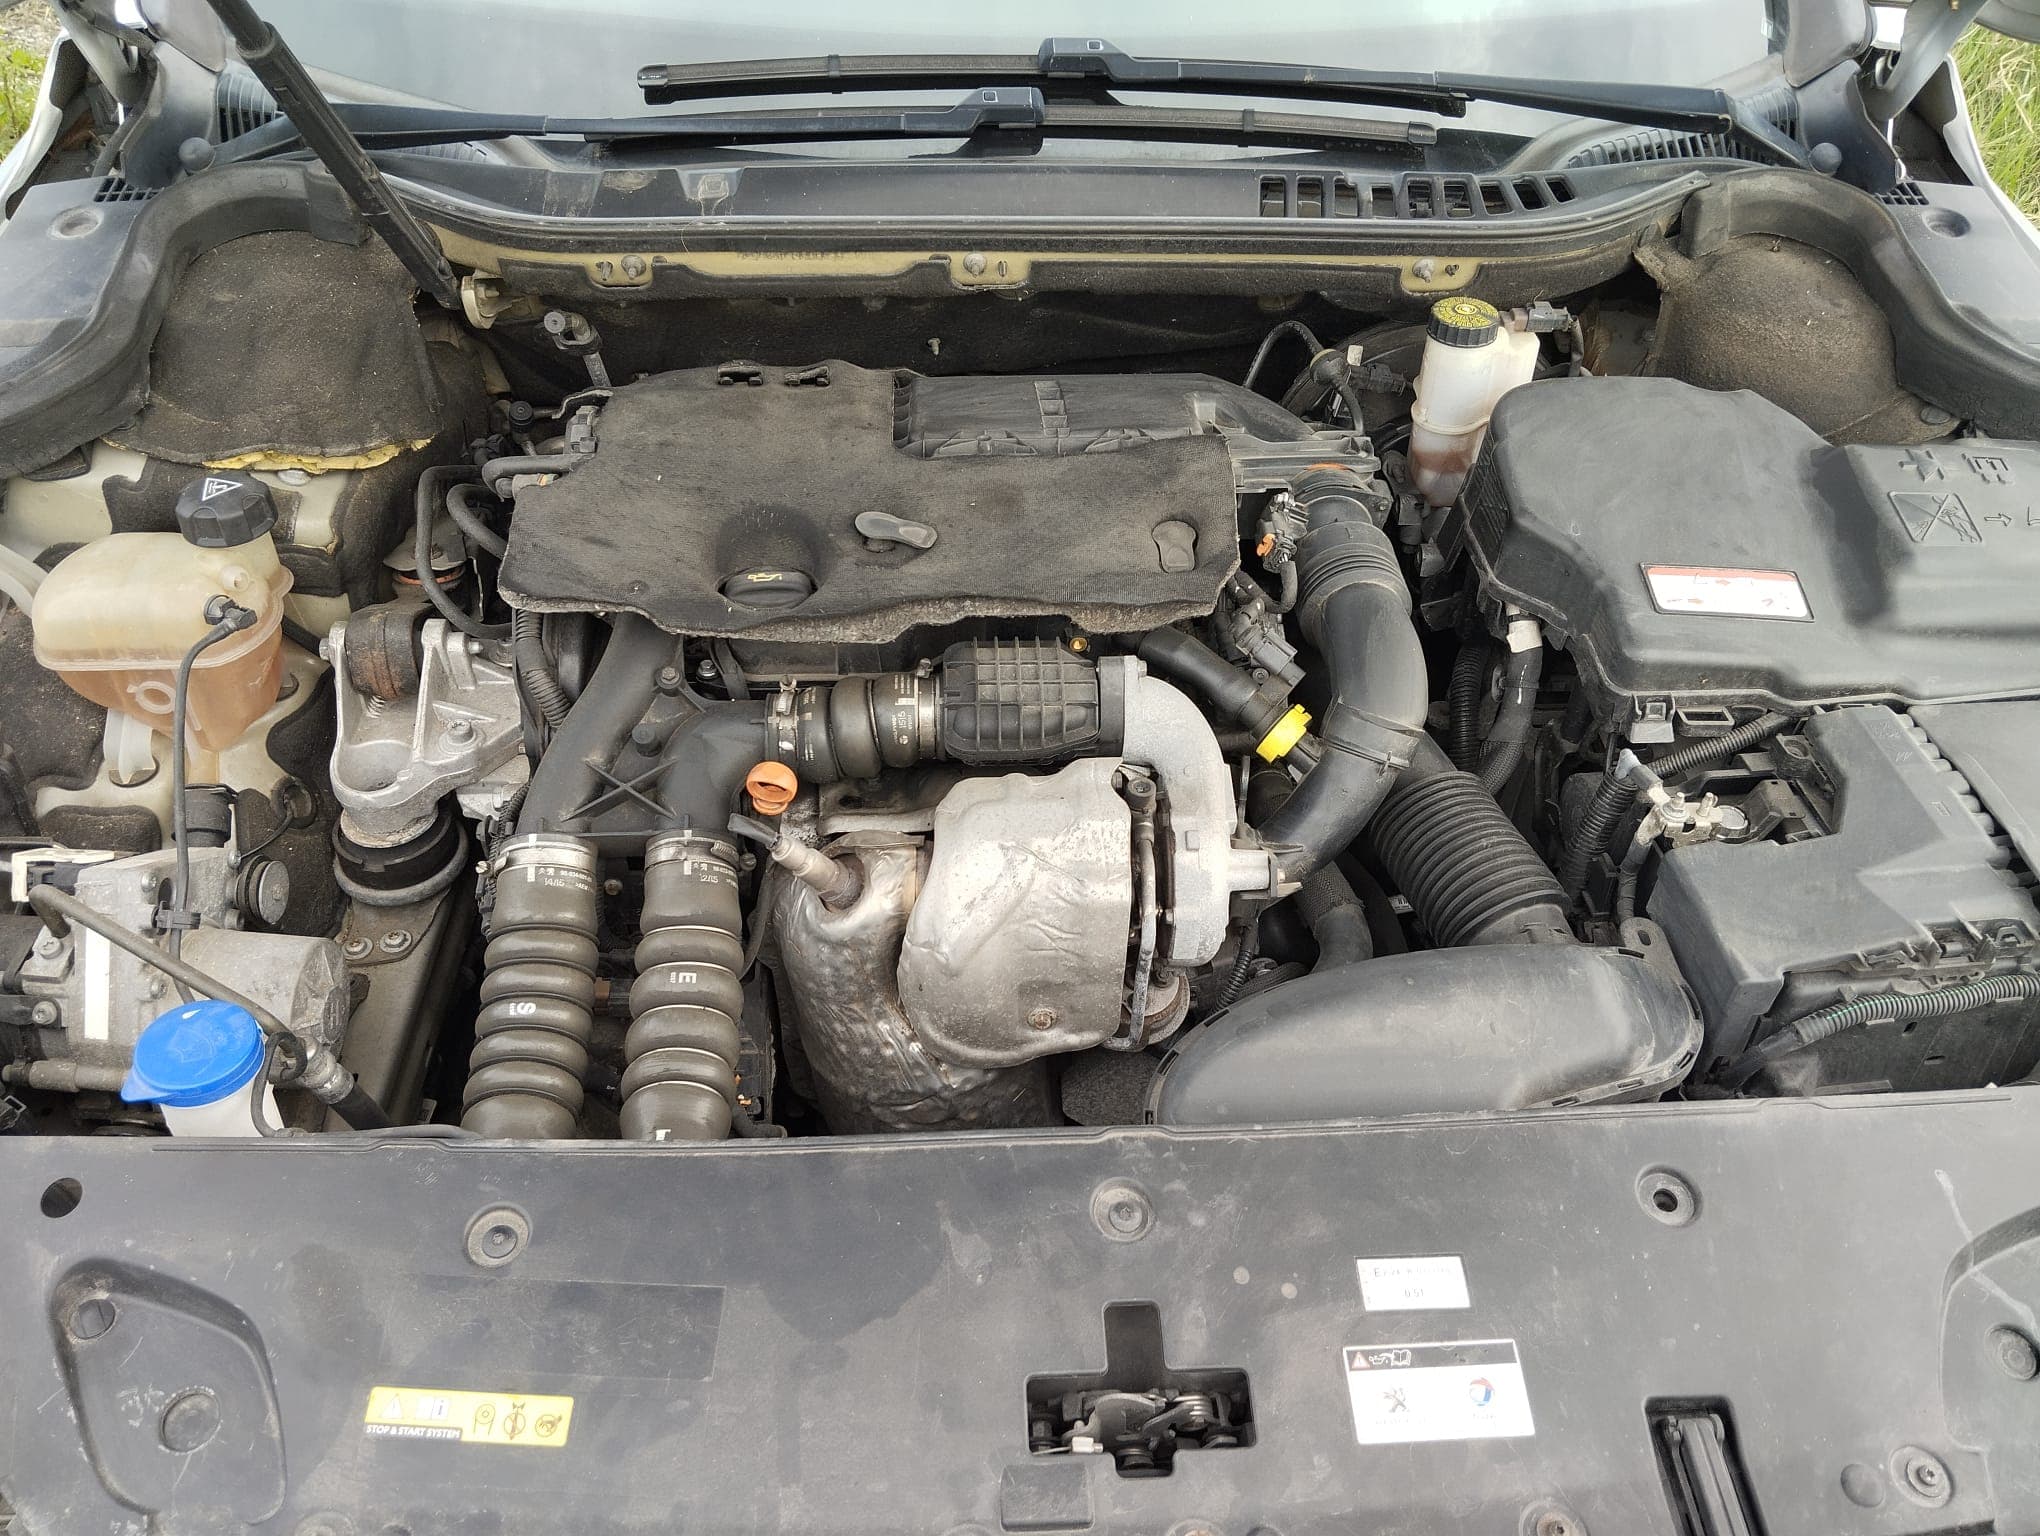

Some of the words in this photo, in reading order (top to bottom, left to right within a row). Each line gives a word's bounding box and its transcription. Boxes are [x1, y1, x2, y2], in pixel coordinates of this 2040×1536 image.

[366, 1424, 389, 1434] STOP
[390, 1426, 397, 1435] &
[398, 1426, 426, 1437] START
[427, 1428, 460, 1438] SYSTEM
